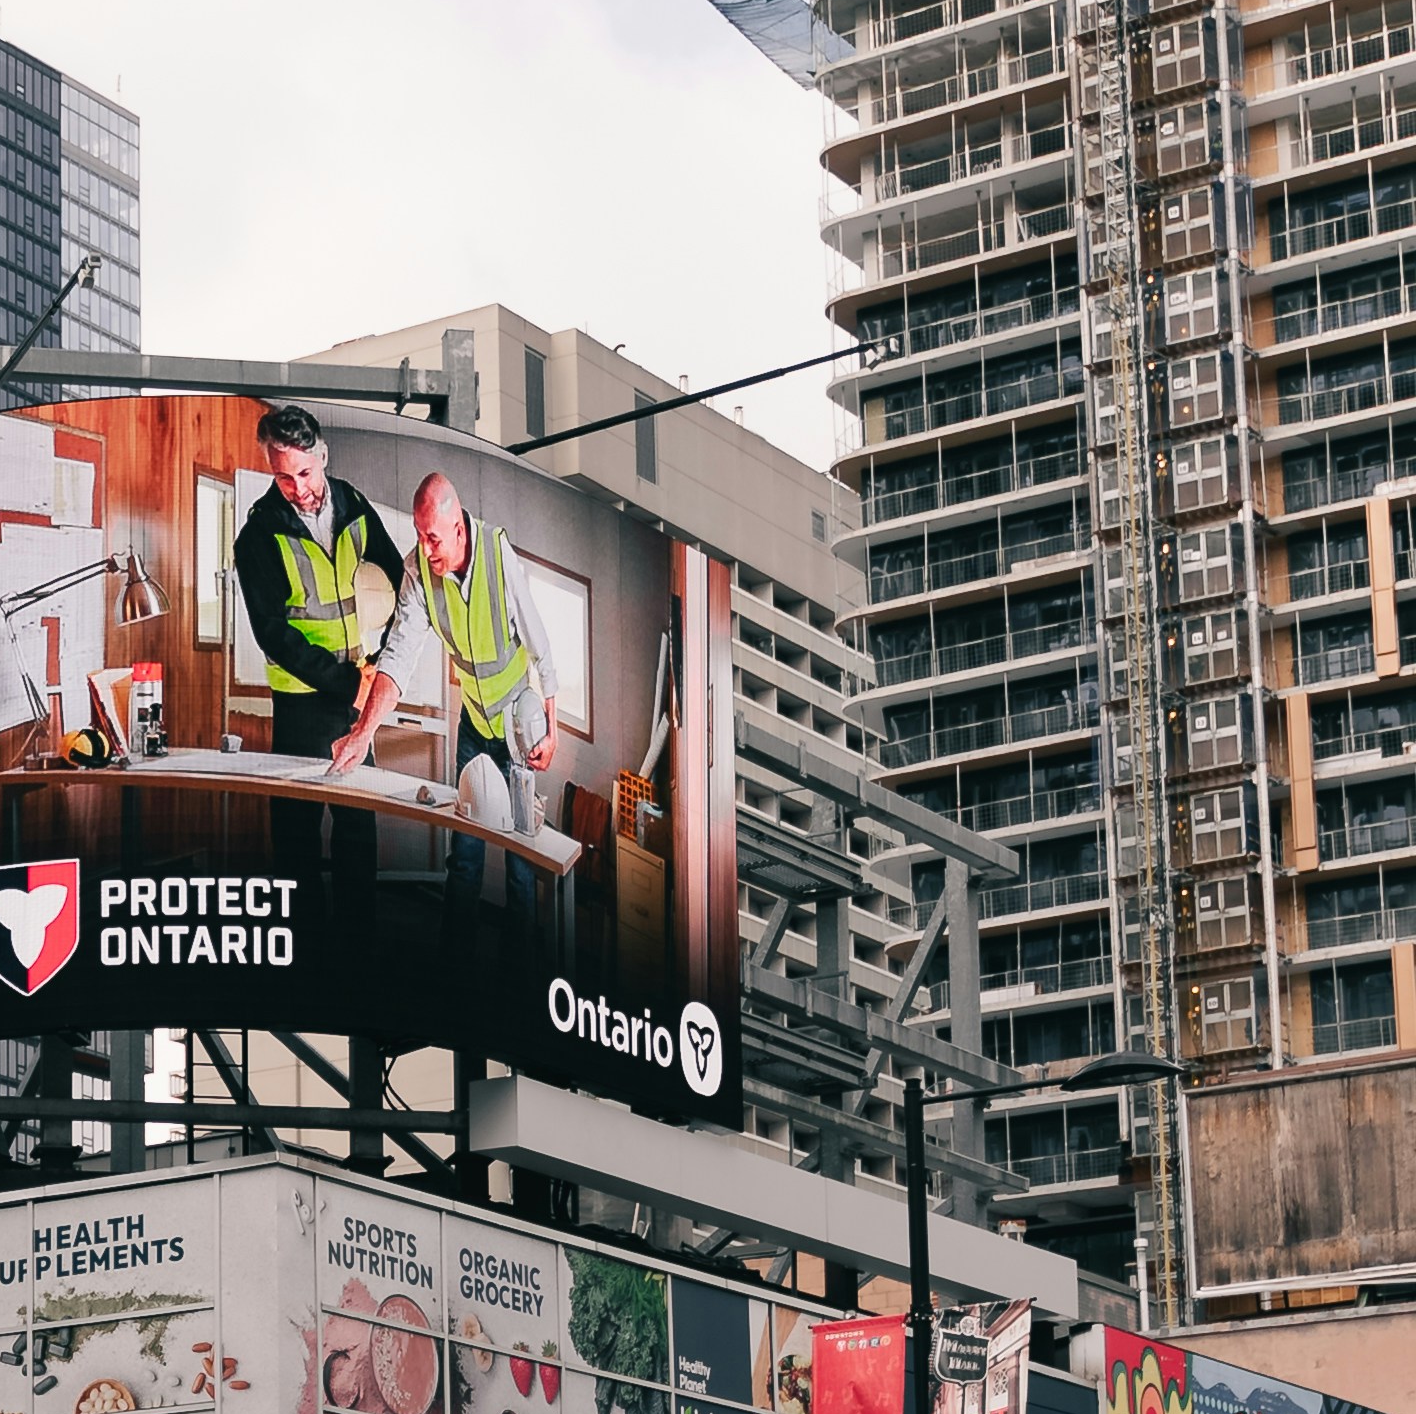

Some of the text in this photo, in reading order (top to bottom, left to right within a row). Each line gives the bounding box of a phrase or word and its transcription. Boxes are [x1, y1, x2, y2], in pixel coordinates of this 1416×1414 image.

[100, 878, 298, 917] PROTECT
[100, 925, 294, 966] ONTARIO
[548, 977, 674, 1068] Ontario
[34, 1214, 145, 1253] HEALTH
[343, 1215, 418, 1258] SPORTS
[328, 1240, 434, 1290] NUTRITION
[458, 1247, 542, 1288] ORGANIC
[460, 1277, 545, 1318] GROCERY
[678, 1355, 712, 1381] Healthy
[679, 1373, 707, 1395] Planet
